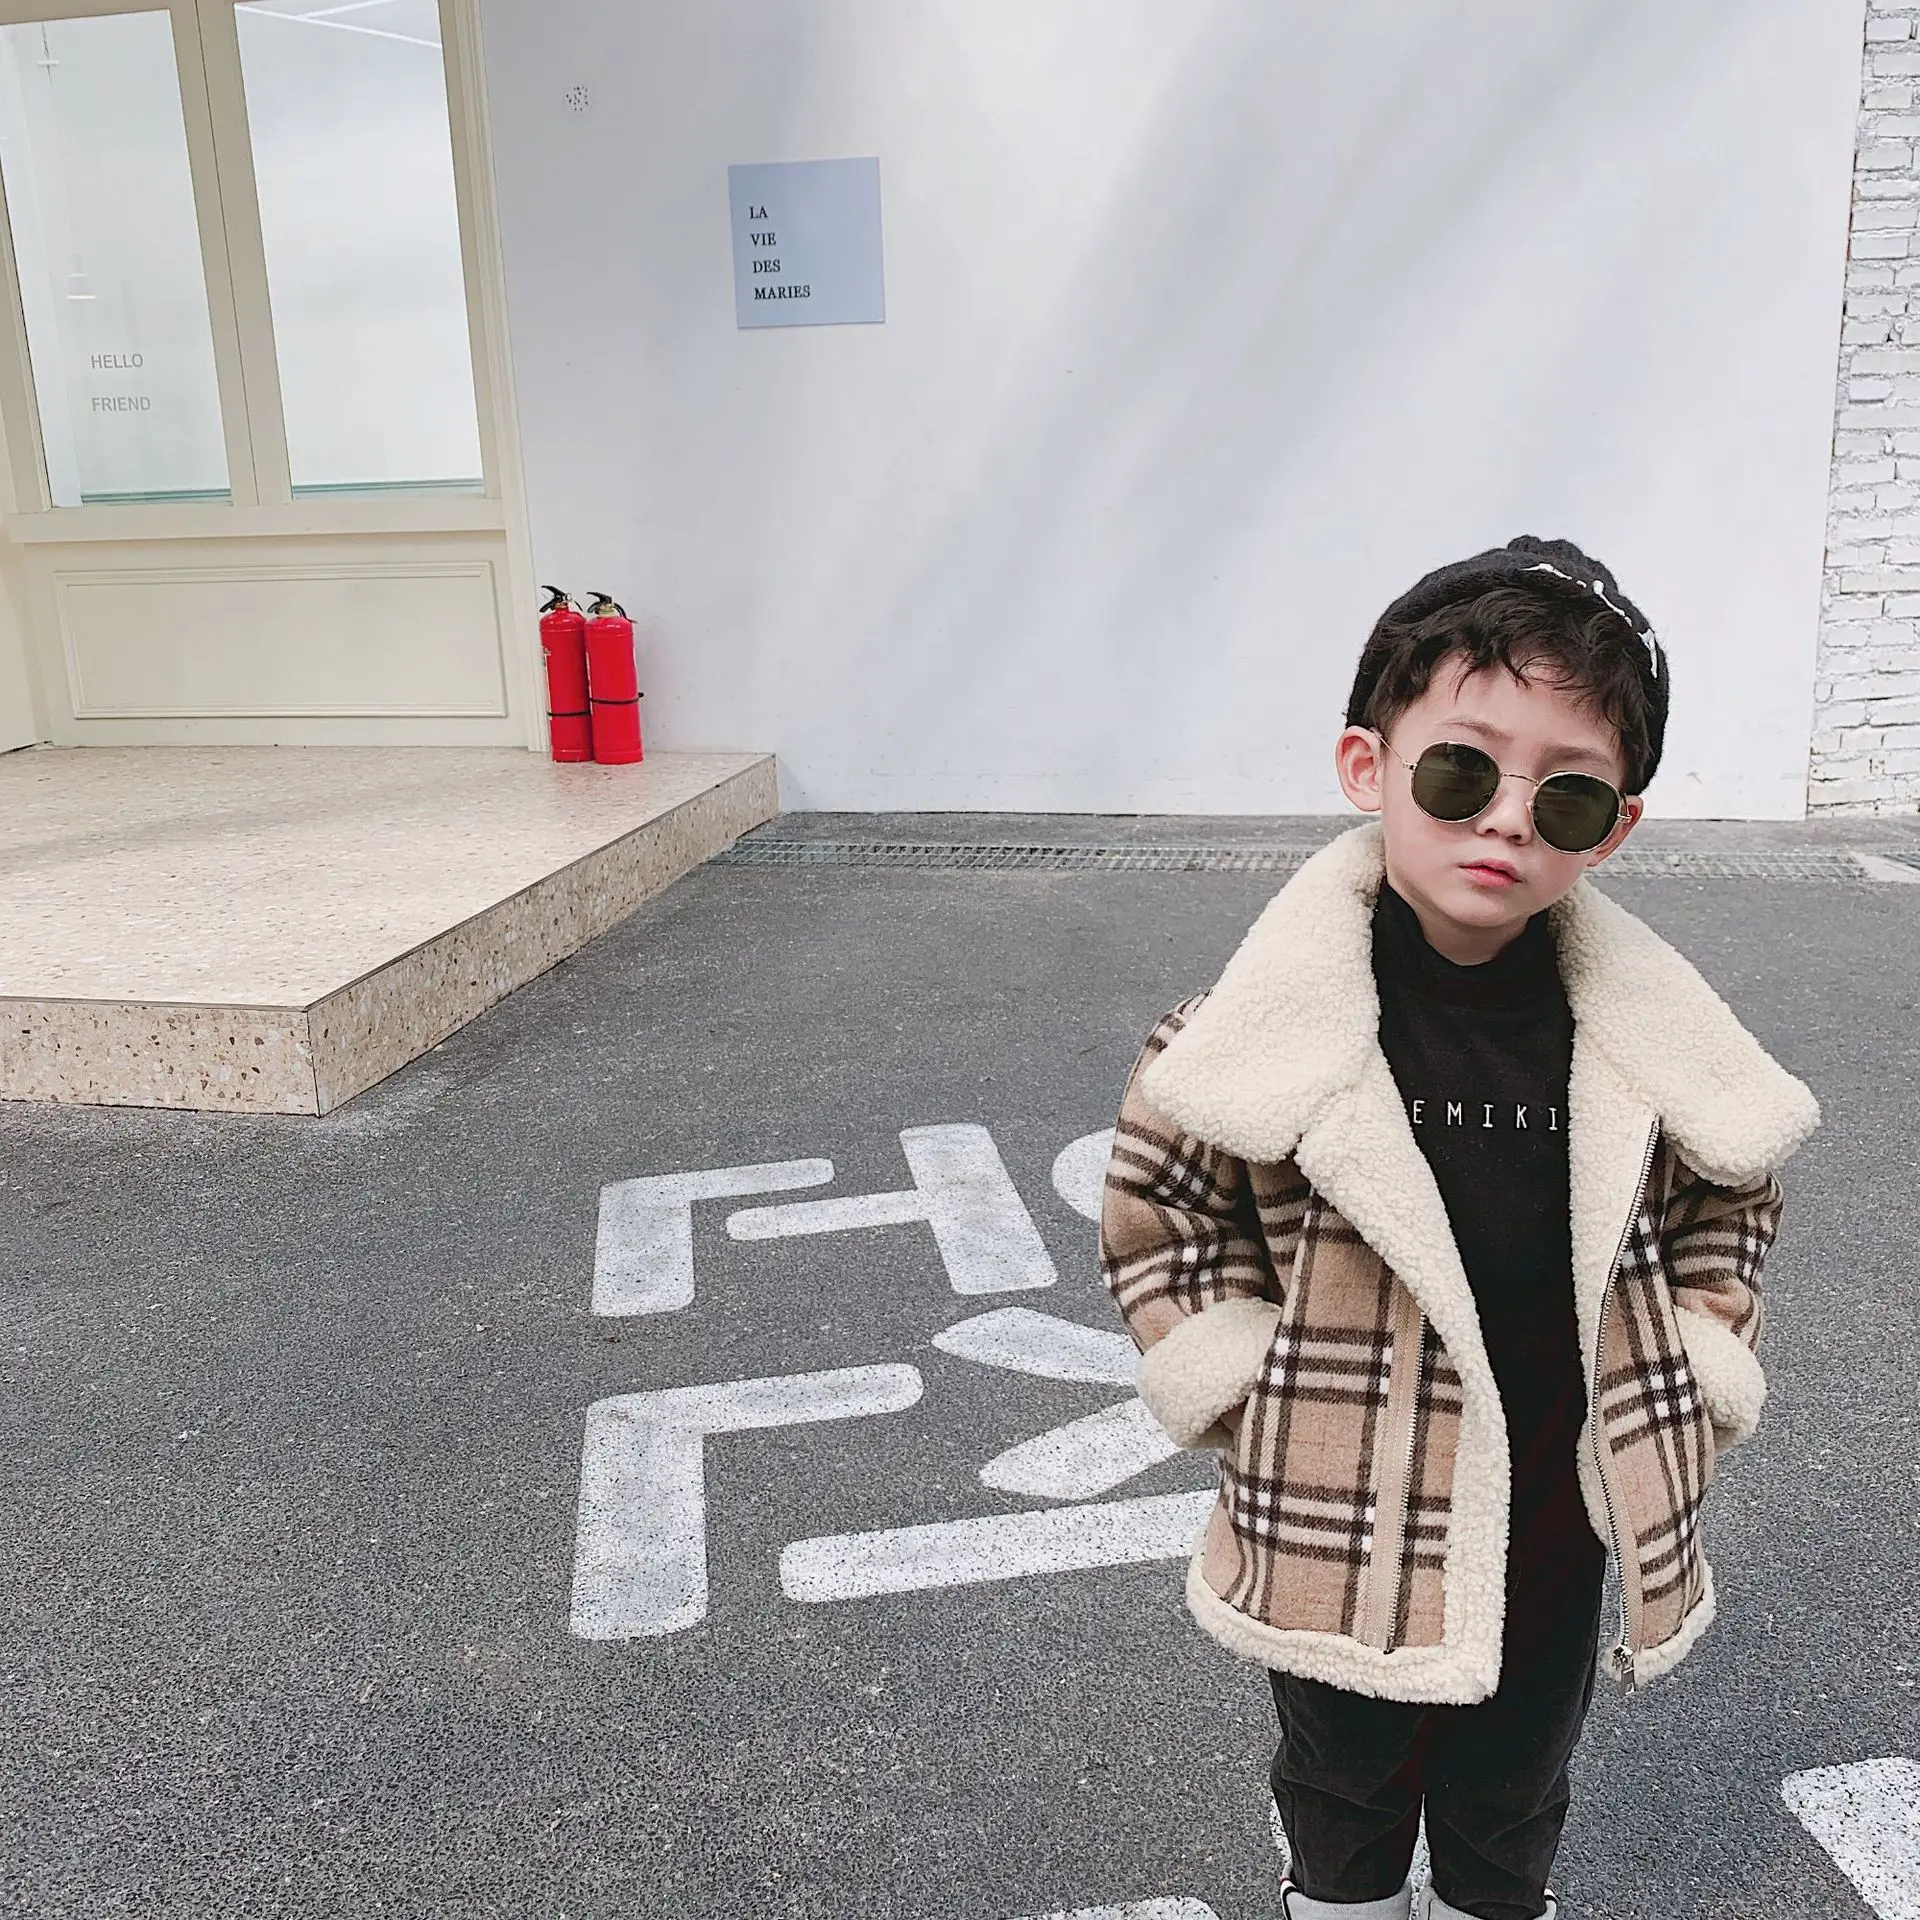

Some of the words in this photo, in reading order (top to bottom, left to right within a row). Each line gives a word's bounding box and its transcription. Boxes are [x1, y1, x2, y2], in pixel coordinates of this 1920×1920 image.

[749, 206, 769, 220] LA
[750, 232, 777, 247] VIE
[752, 259, 781, 273] DES
[754, 285, 811, 300] MARIES
[91, 353, 144, 369] HELLO
[91, 396, 151, 412] FRIEND
